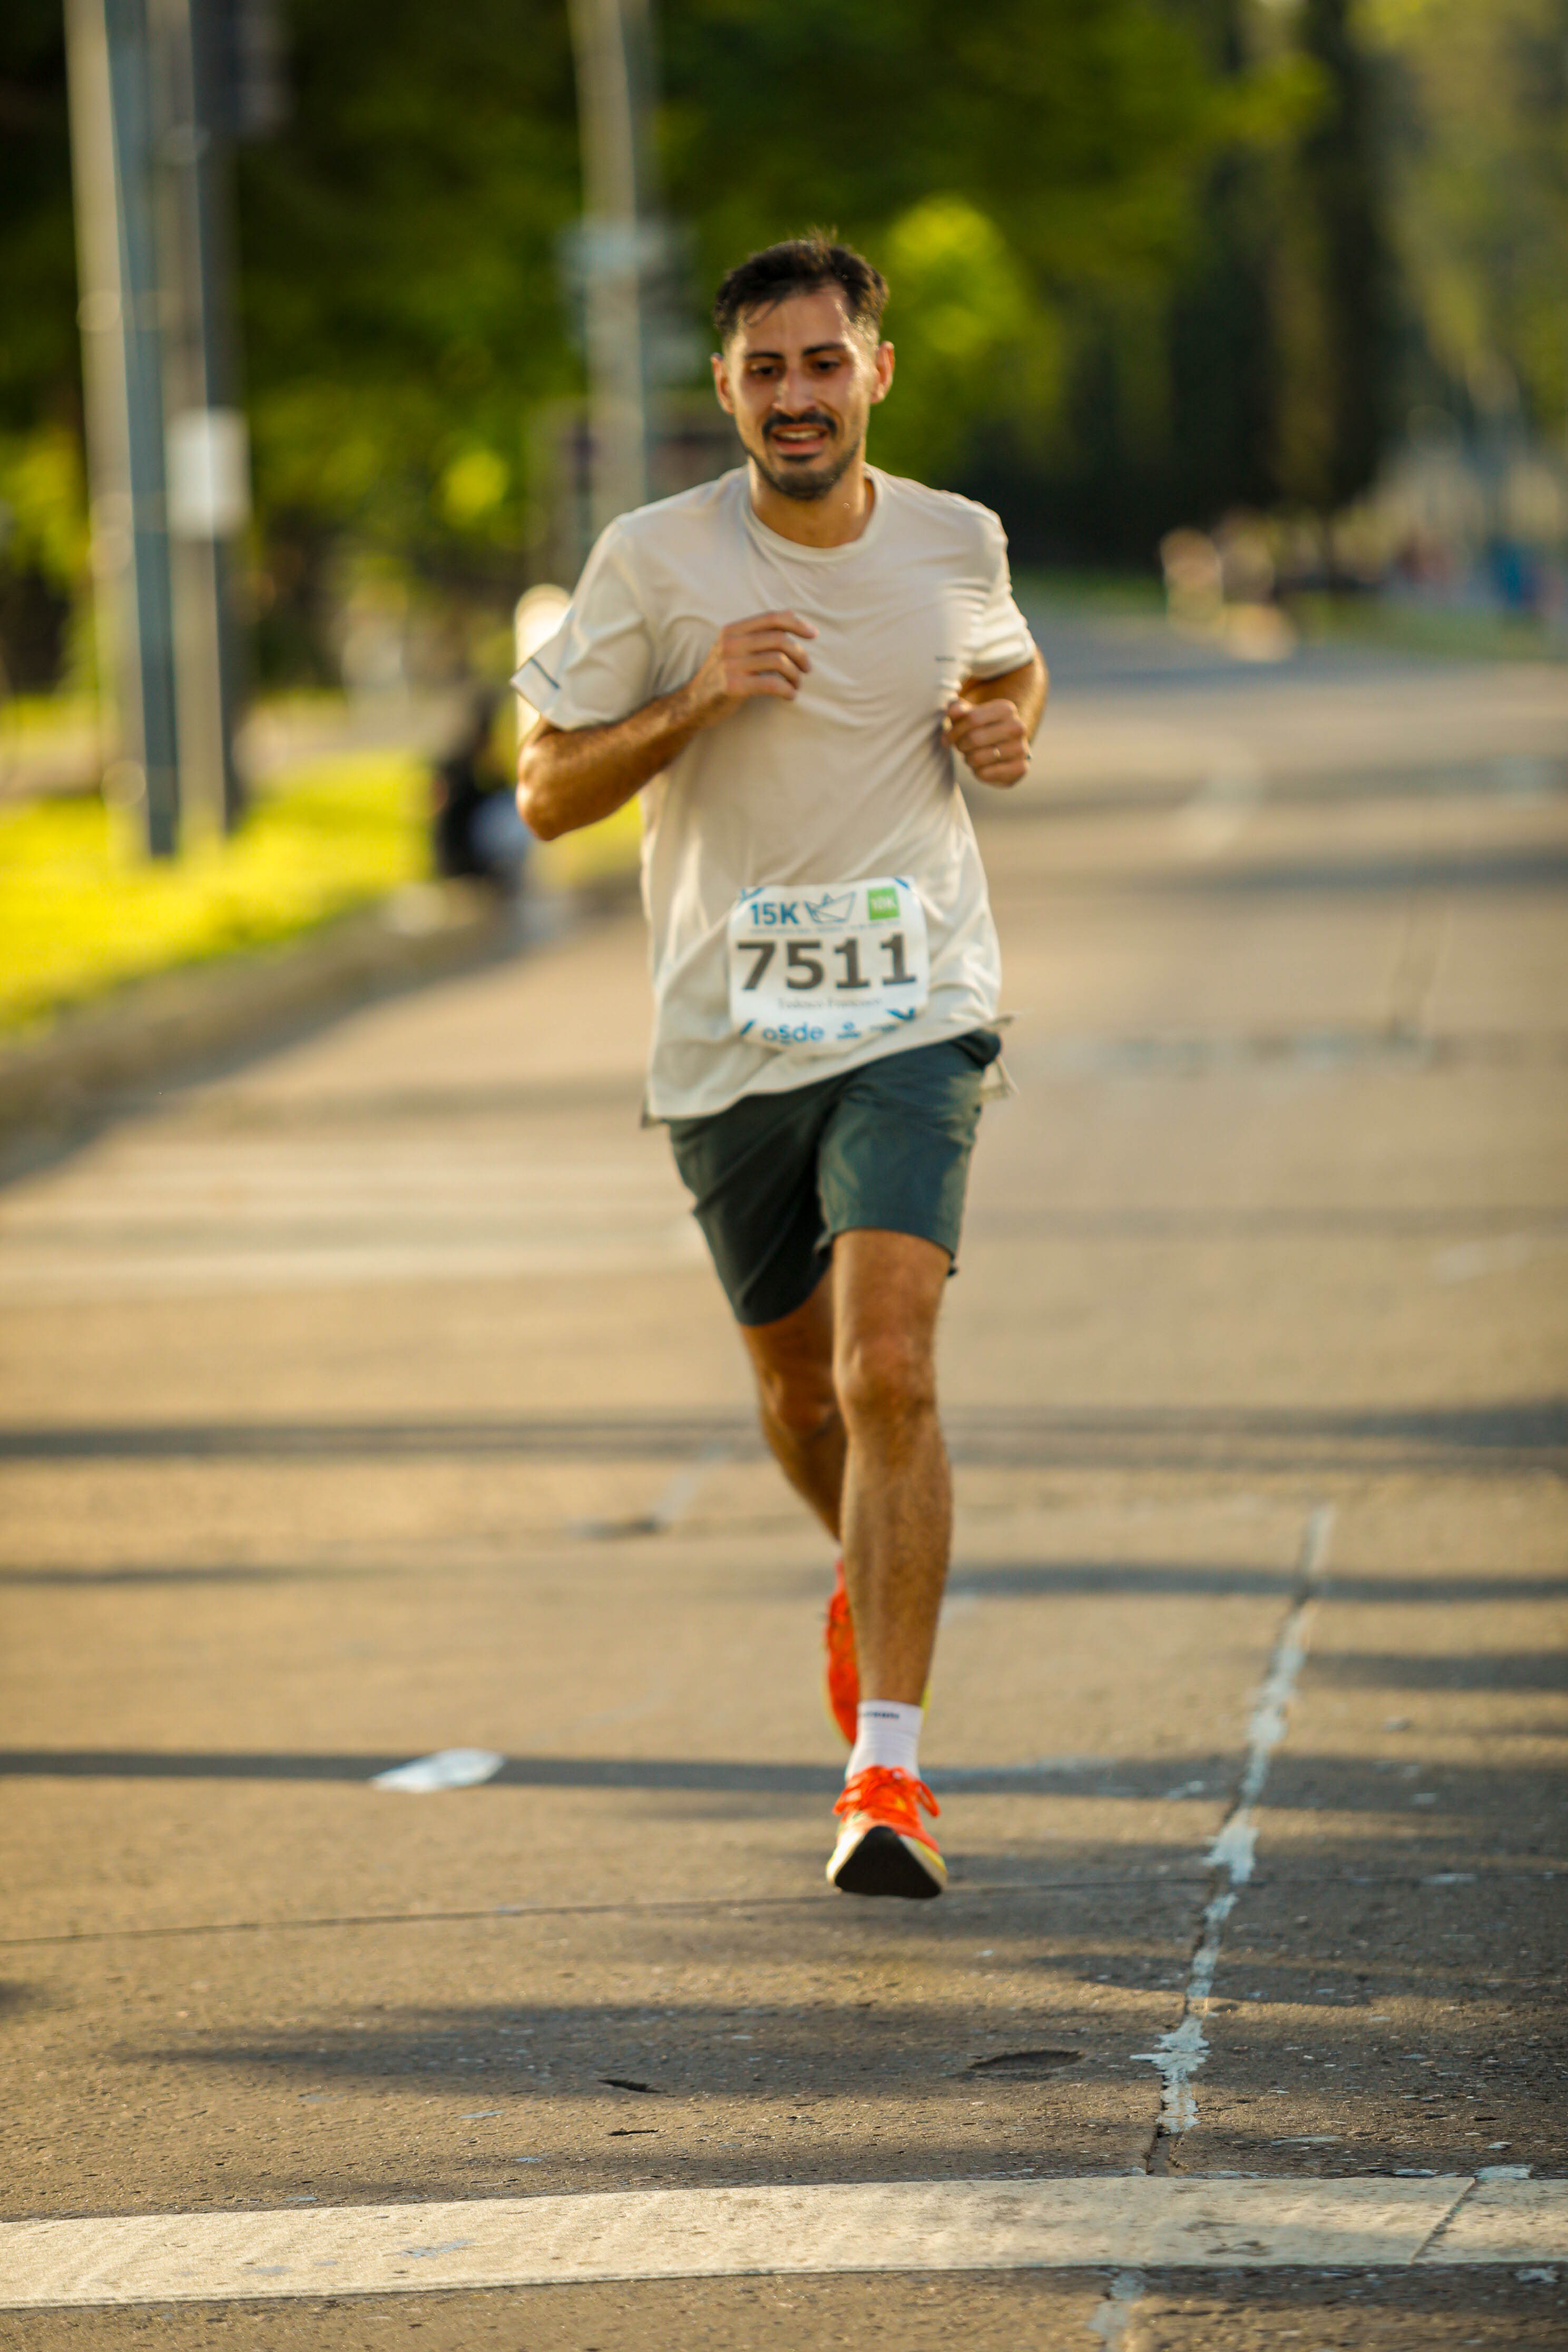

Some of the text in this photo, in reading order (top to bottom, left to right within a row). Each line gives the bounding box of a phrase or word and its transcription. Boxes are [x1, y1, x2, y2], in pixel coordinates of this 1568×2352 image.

[750, 903, 799, 925] 15K
[737, 933, 916, 990] 7511
[762, 1022, 824, 1042] osde
